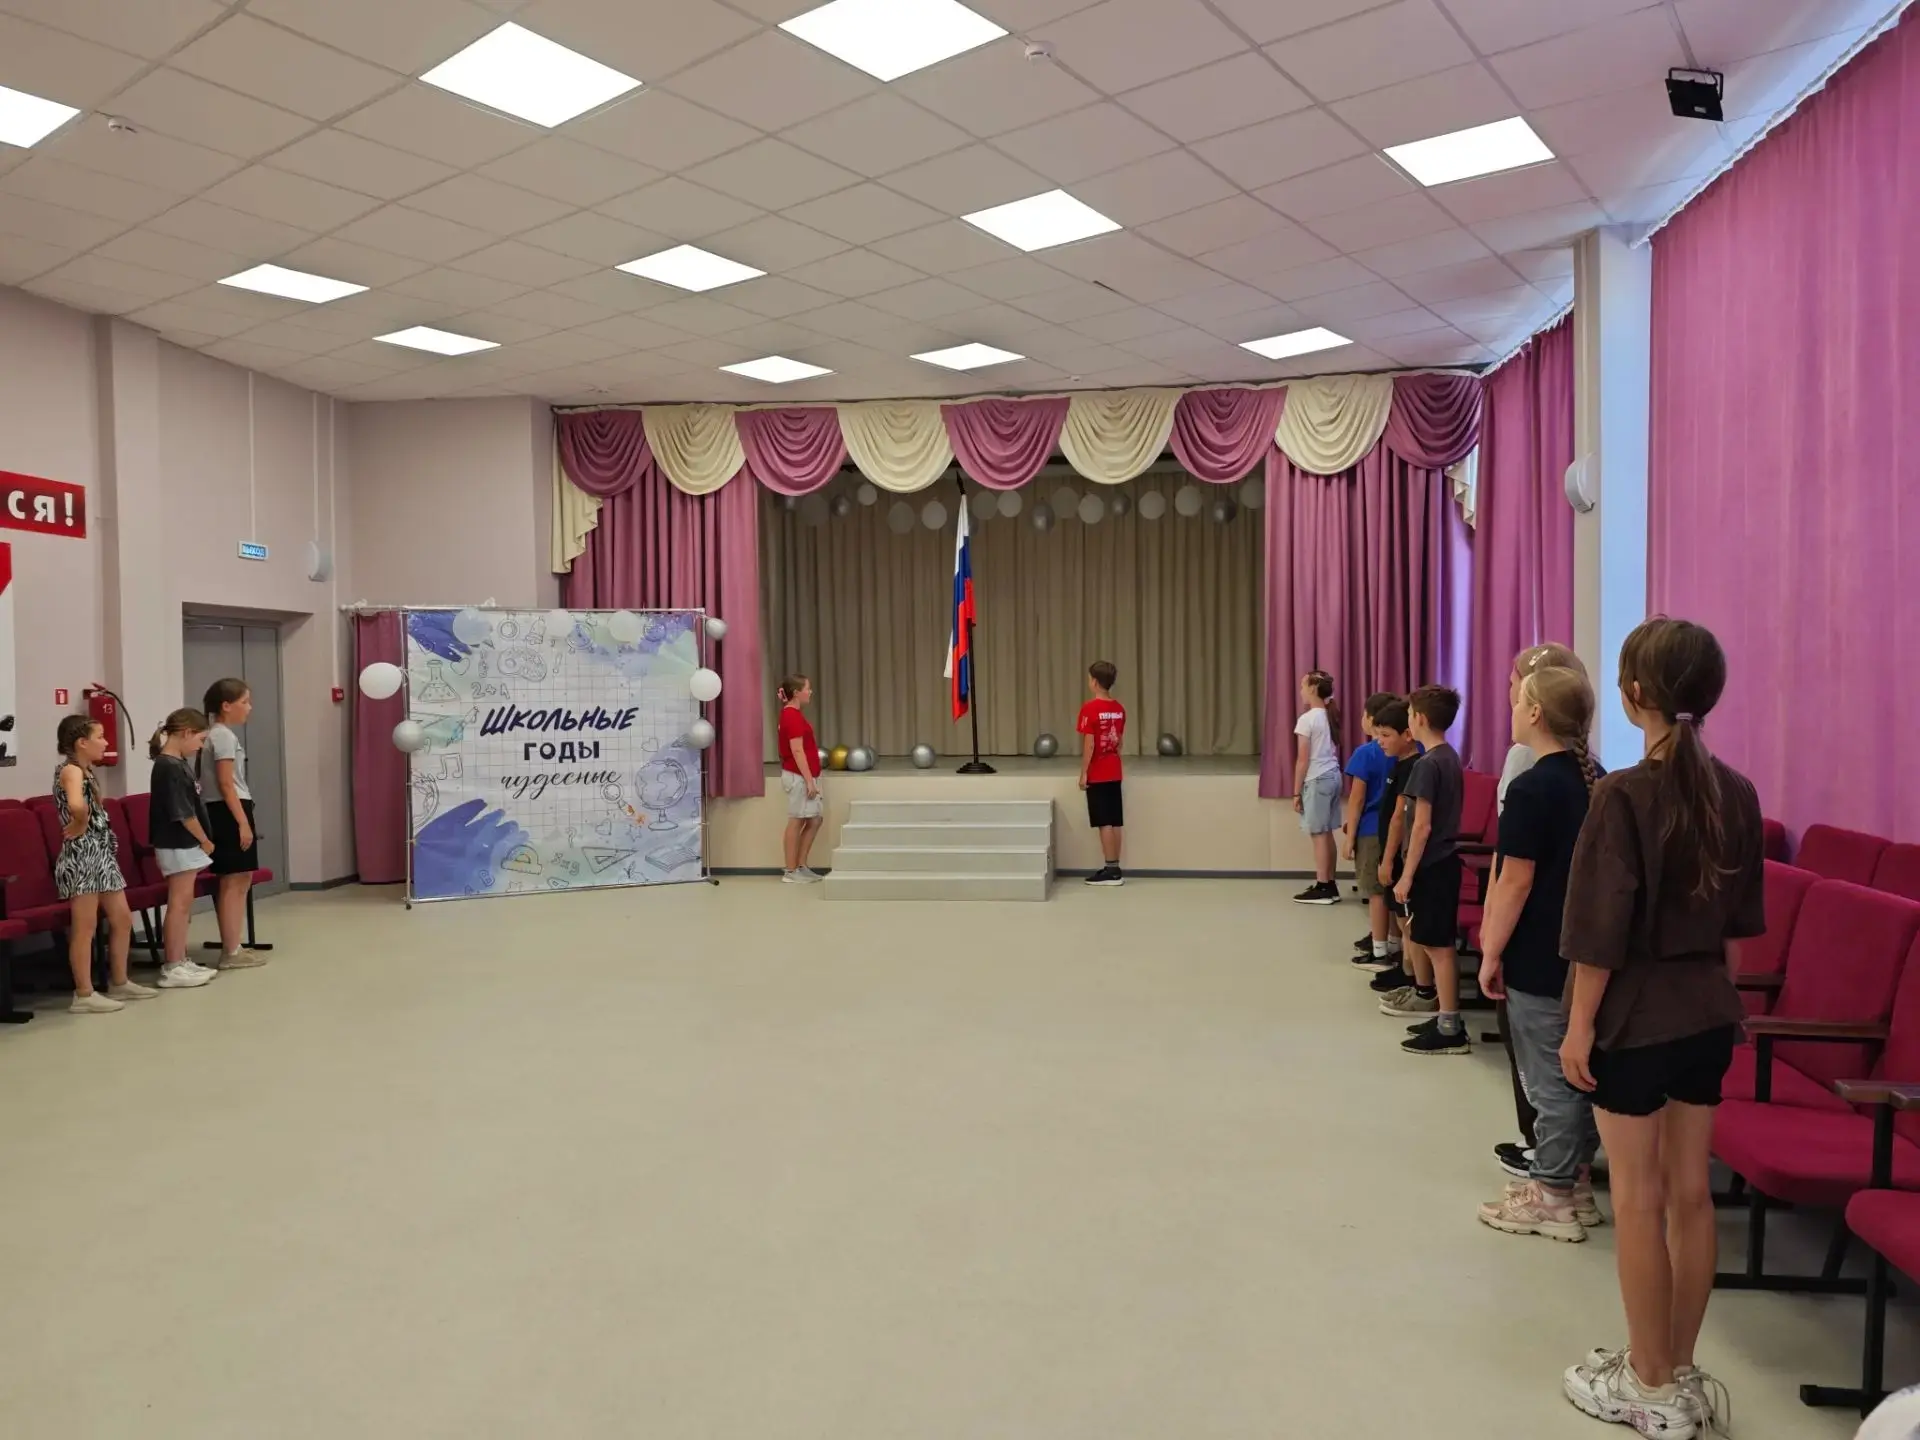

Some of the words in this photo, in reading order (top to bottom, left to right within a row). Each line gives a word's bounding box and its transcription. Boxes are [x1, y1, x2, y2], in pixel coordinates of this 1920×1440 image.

[102, 703, 114, 714] 13
[479, 703, 640, 737] ШКОЛЬНЫЕ
[500, 770, 622, 801] чудесные
